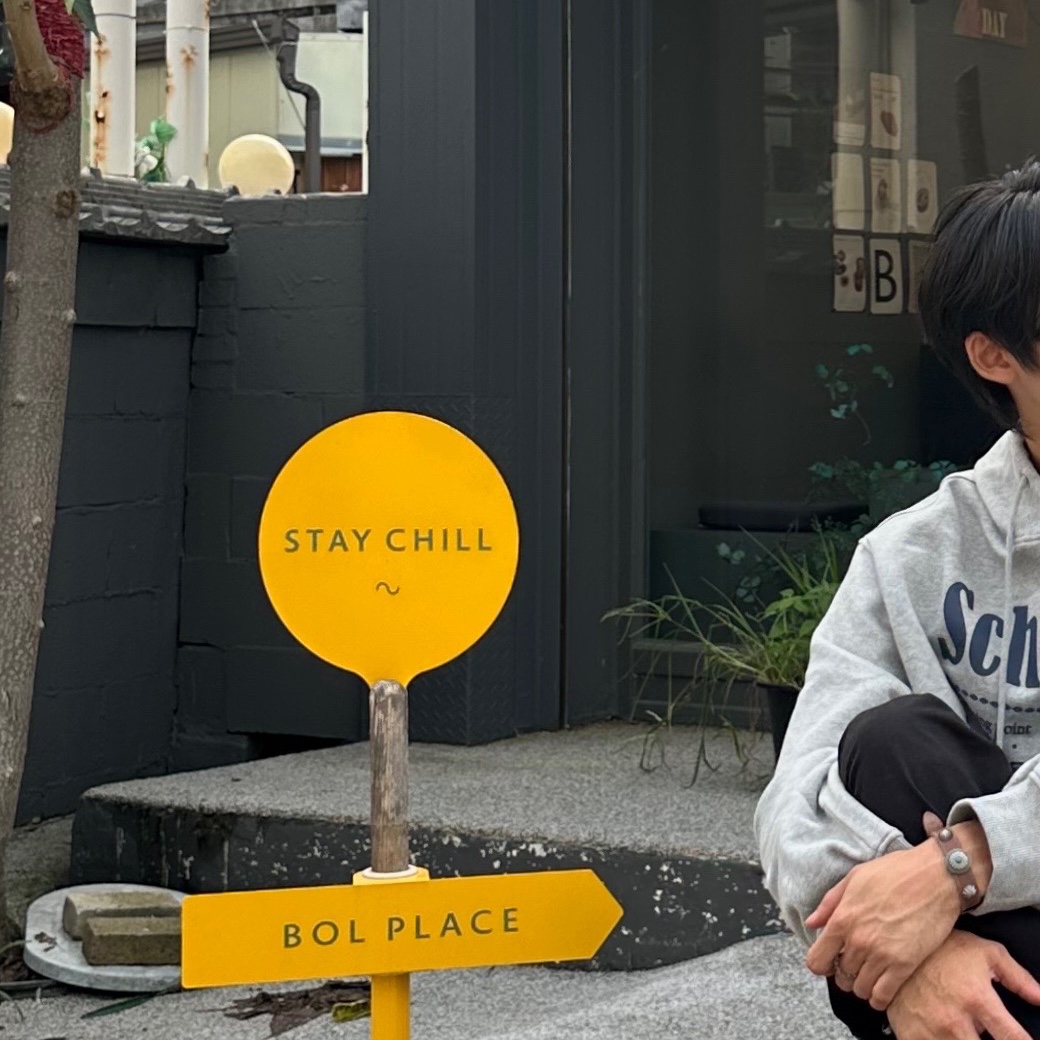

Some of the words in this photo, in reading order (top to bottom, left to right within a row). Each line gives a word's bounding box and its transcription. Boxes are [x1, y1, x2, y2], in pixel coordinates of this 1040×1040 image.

[875, 250, 897, 302] B
[284, 528, 371, 553] STAY
[385, 528, 492, 552] CHILL
[997, 721, 1032, 737] oint
[283, 919, 365, 949] BOL
[387, 907, 519, 941] PLACE
